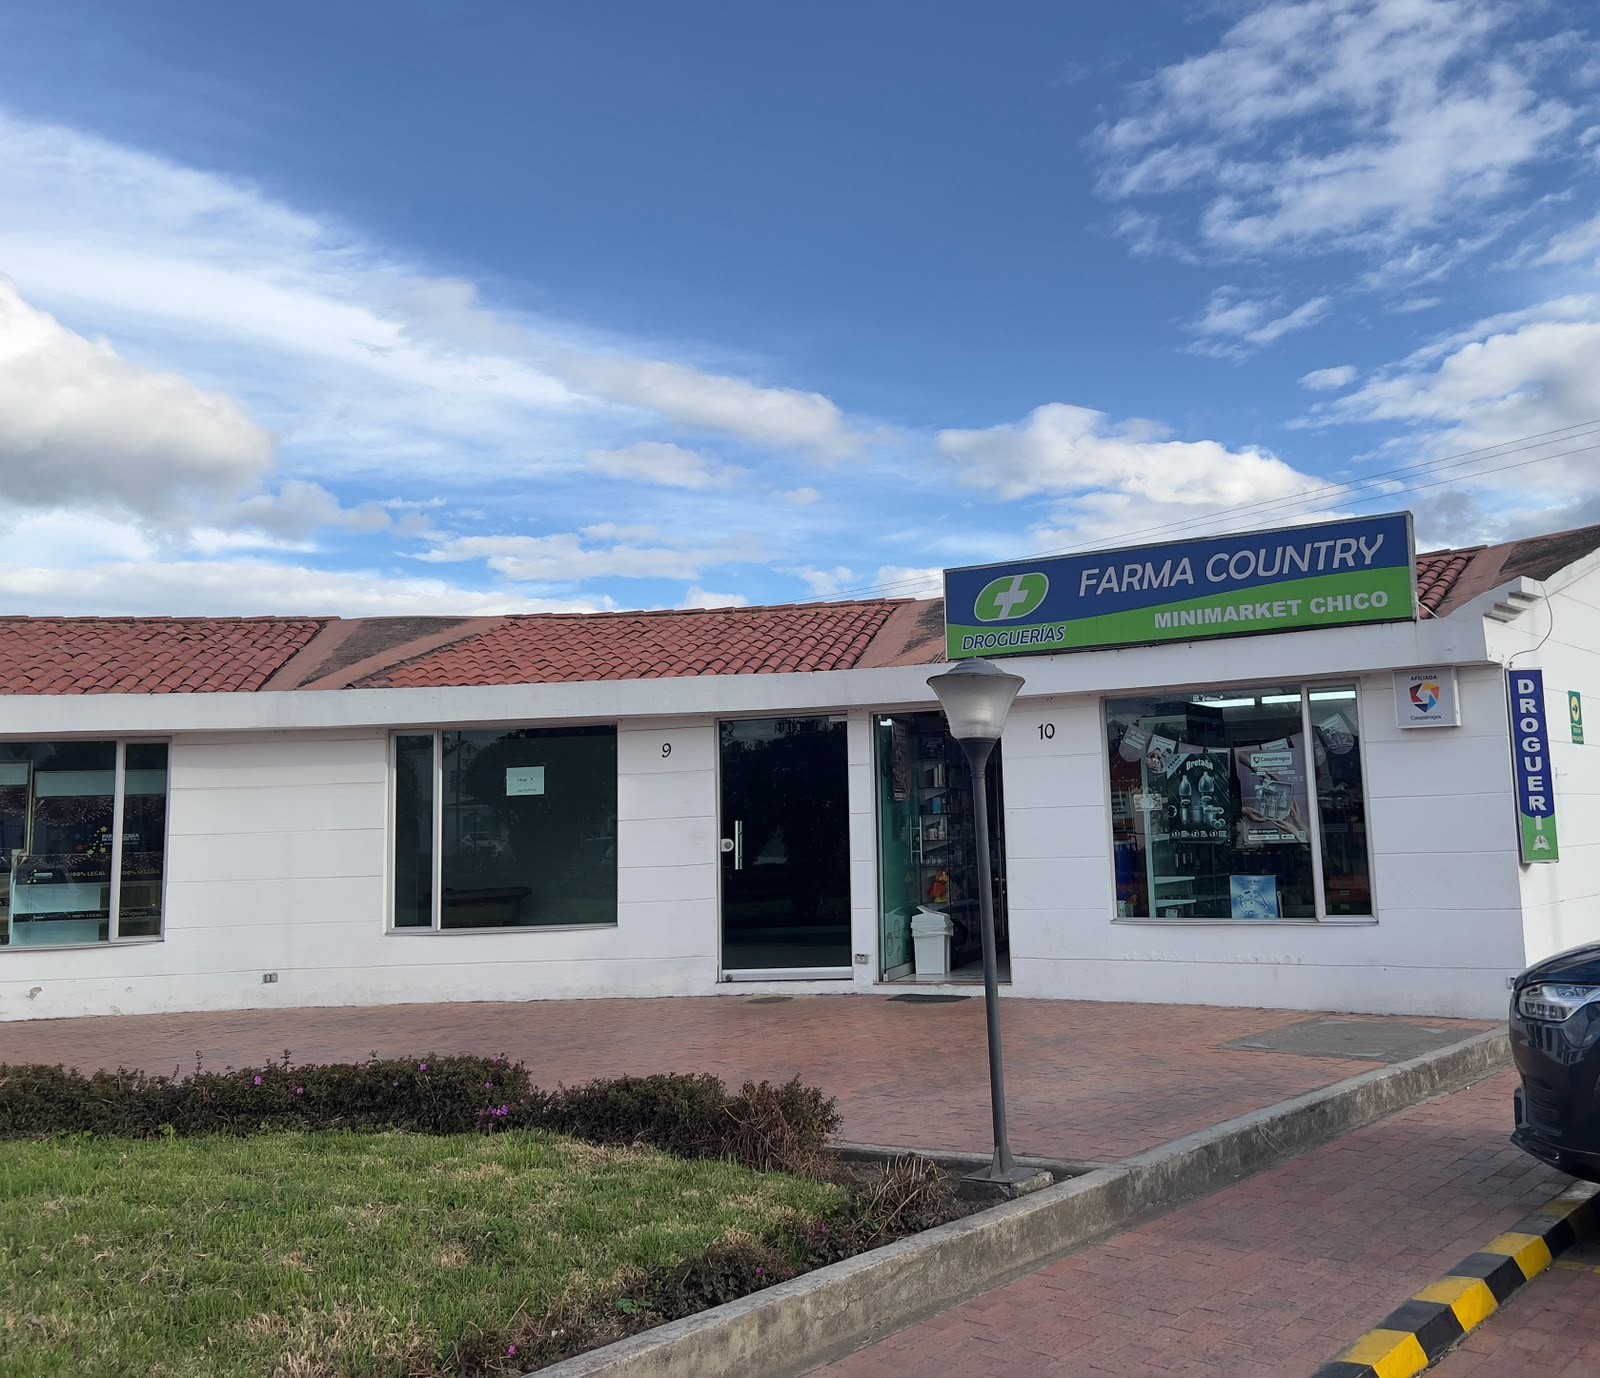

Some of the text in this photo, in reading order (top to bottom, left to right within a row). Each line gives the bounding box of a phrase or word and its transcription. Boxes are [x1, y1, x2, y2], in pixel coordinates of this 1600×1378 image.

[1079, 534, 1384, 598] FARMA COUNTRY
[1154, 591, 1389, 629] MINIMARKET CHICO
[961, 624, 1066, 651] DROGUERÍAS
[1037, 723, 1055, 740] 10
[661, 743, 672, 758] 9
[1186, 759, 1213, 771] Bretaña
[1517, 679, 1551, 851] DROGUERIA
